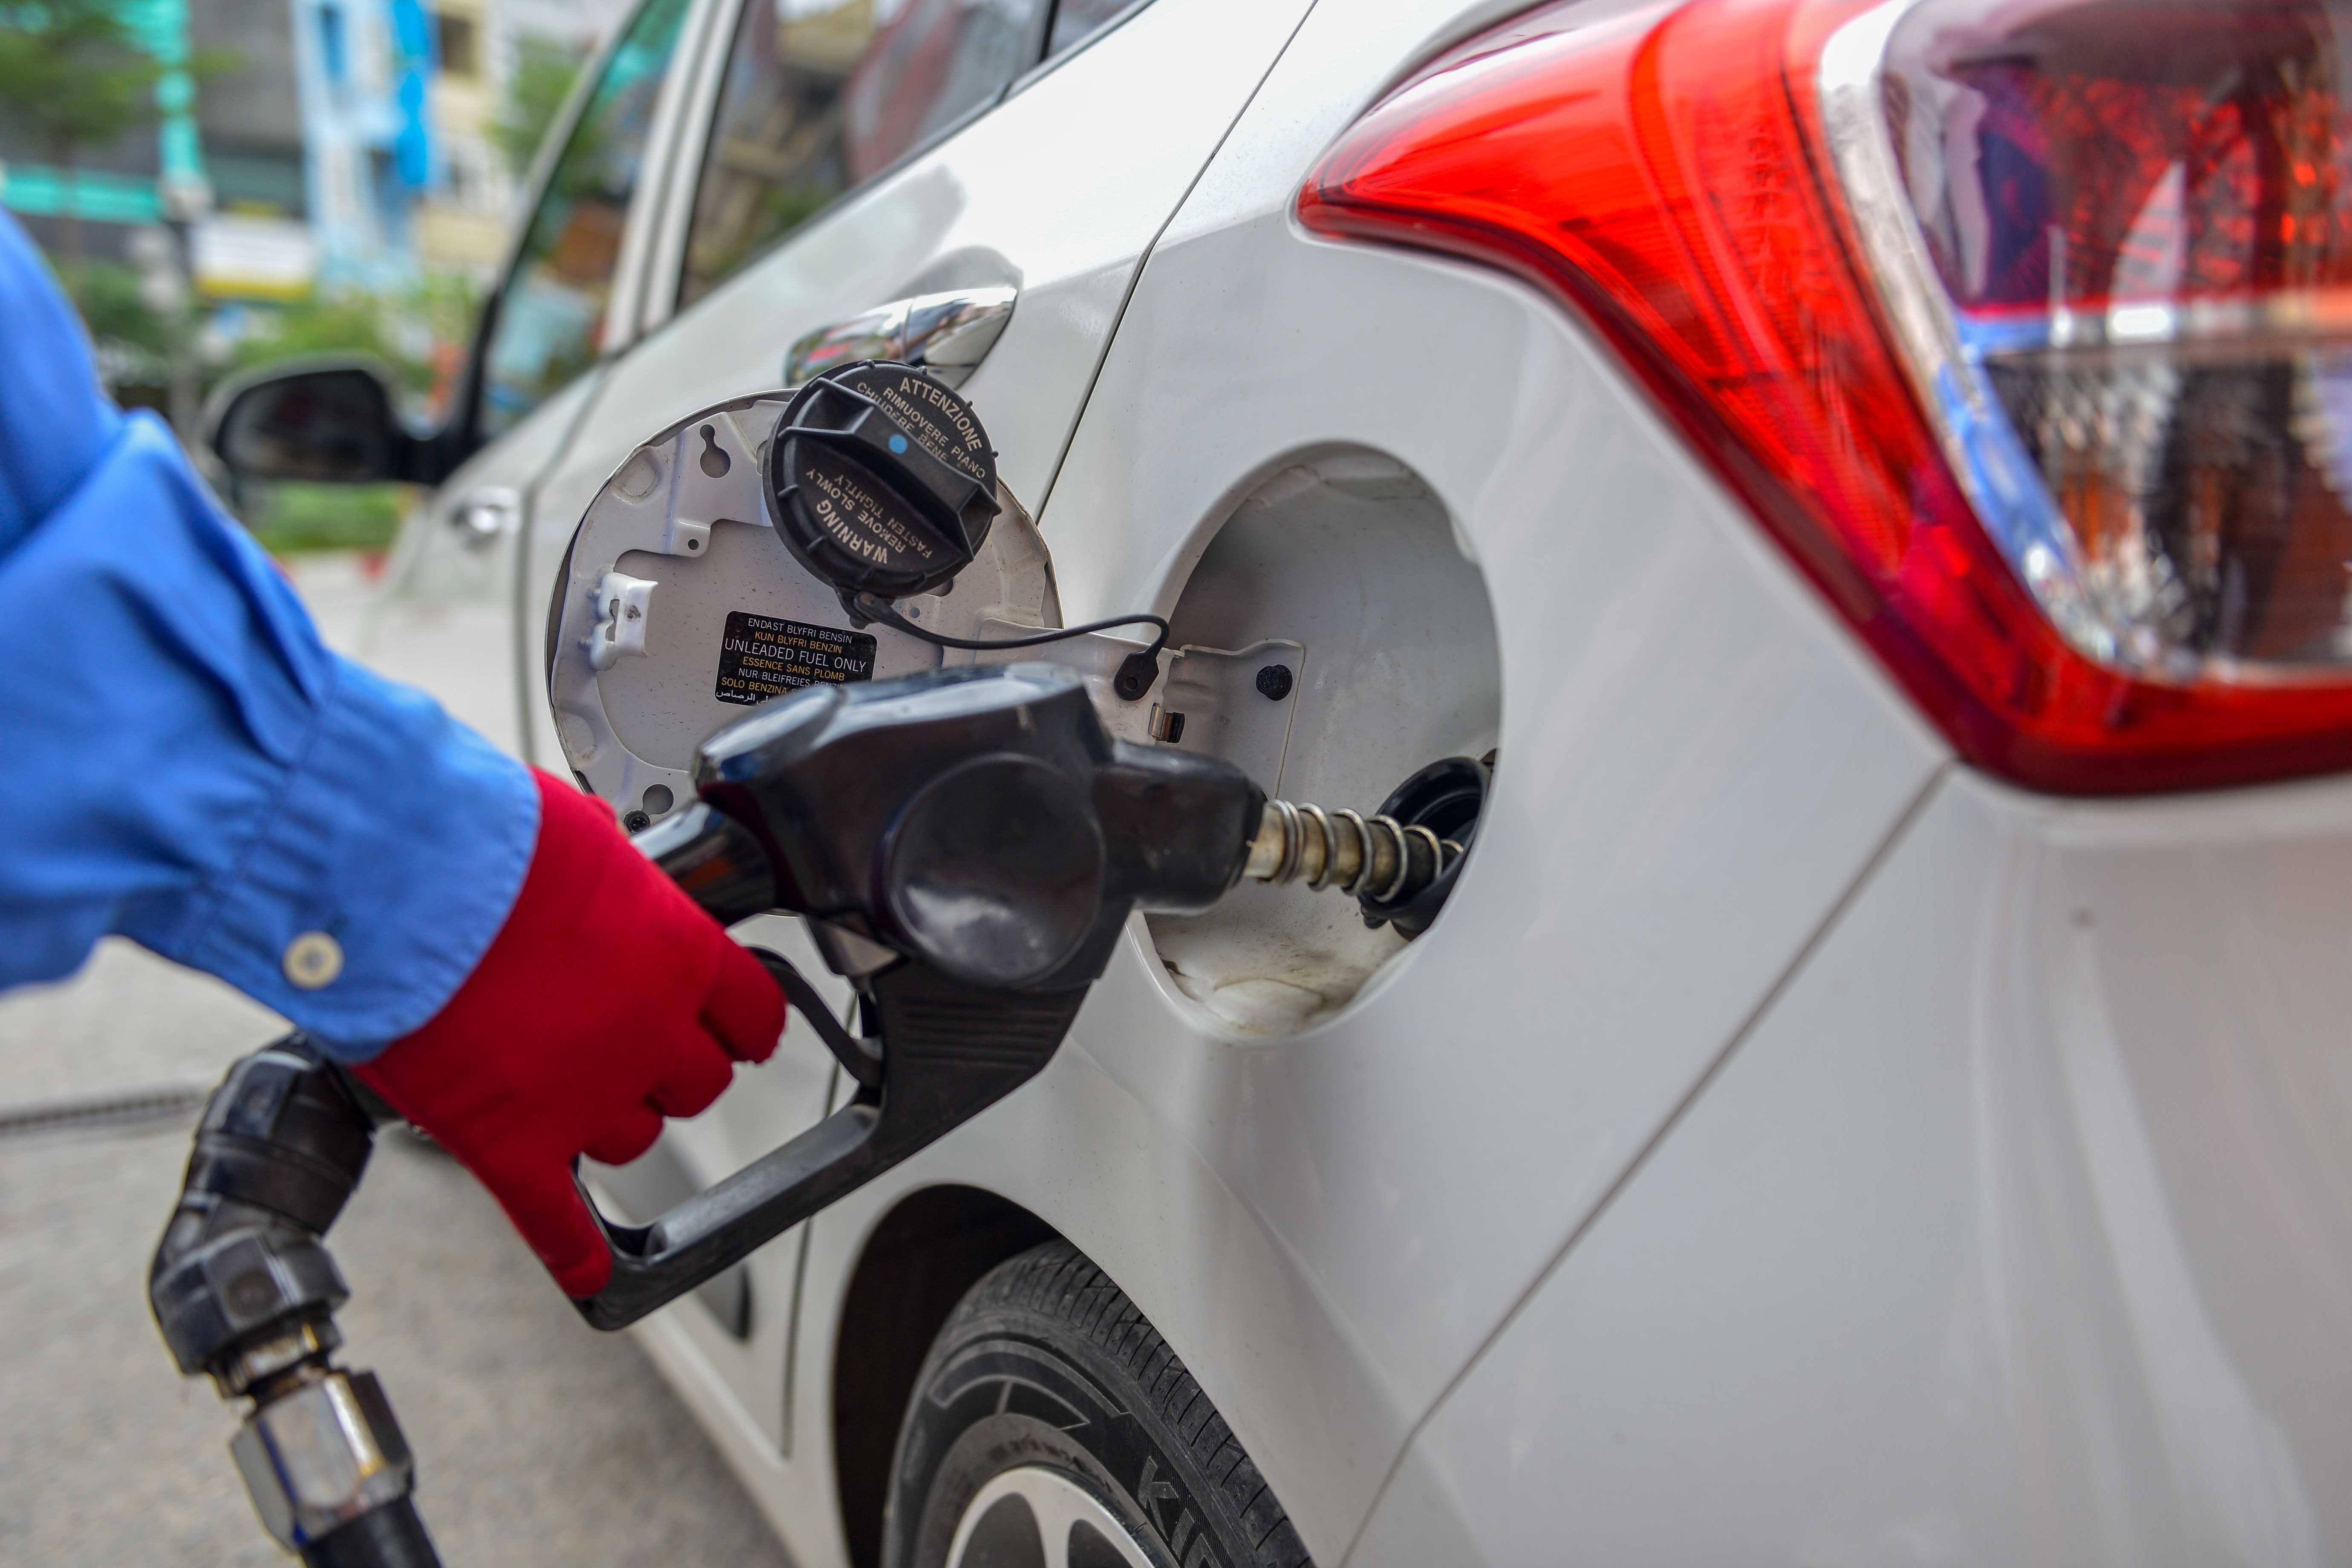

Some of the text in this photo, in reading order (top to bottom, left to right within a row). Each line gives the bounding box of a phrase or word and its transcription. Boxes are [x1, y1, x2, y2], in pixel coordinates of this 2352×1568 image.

[900, 377, 982, 451] ATTENZIONE
[883, 387, 985, 478] RIMUOVERE PIANO
[918, 433, 948, 461] BENE
[806, 469, 906, 553] REMOVE SLOWLY
[834, 475, 933, 558] FASTEN TIGHTLY
[816, 499, 887, 564] WARNING
[748, 618, 852, 644] ENDAST BLYFRI BENSIN
[755, 631, 842, 654] KUN BLYFRI BENZIN
[725, 638, 866, 673] UNLEADED FUEL ONLY
[743, 657, 845, 681] ESSENCE SANS PLOMB
[721, 677, 745, 688] SOLO
[749, 682, 787, 695] BENZINA
[738, 668, 758, 679] NUR
[762, 672, 810, 687] BLEIFREIES
[716, 690, 755, 702] الرصاص
